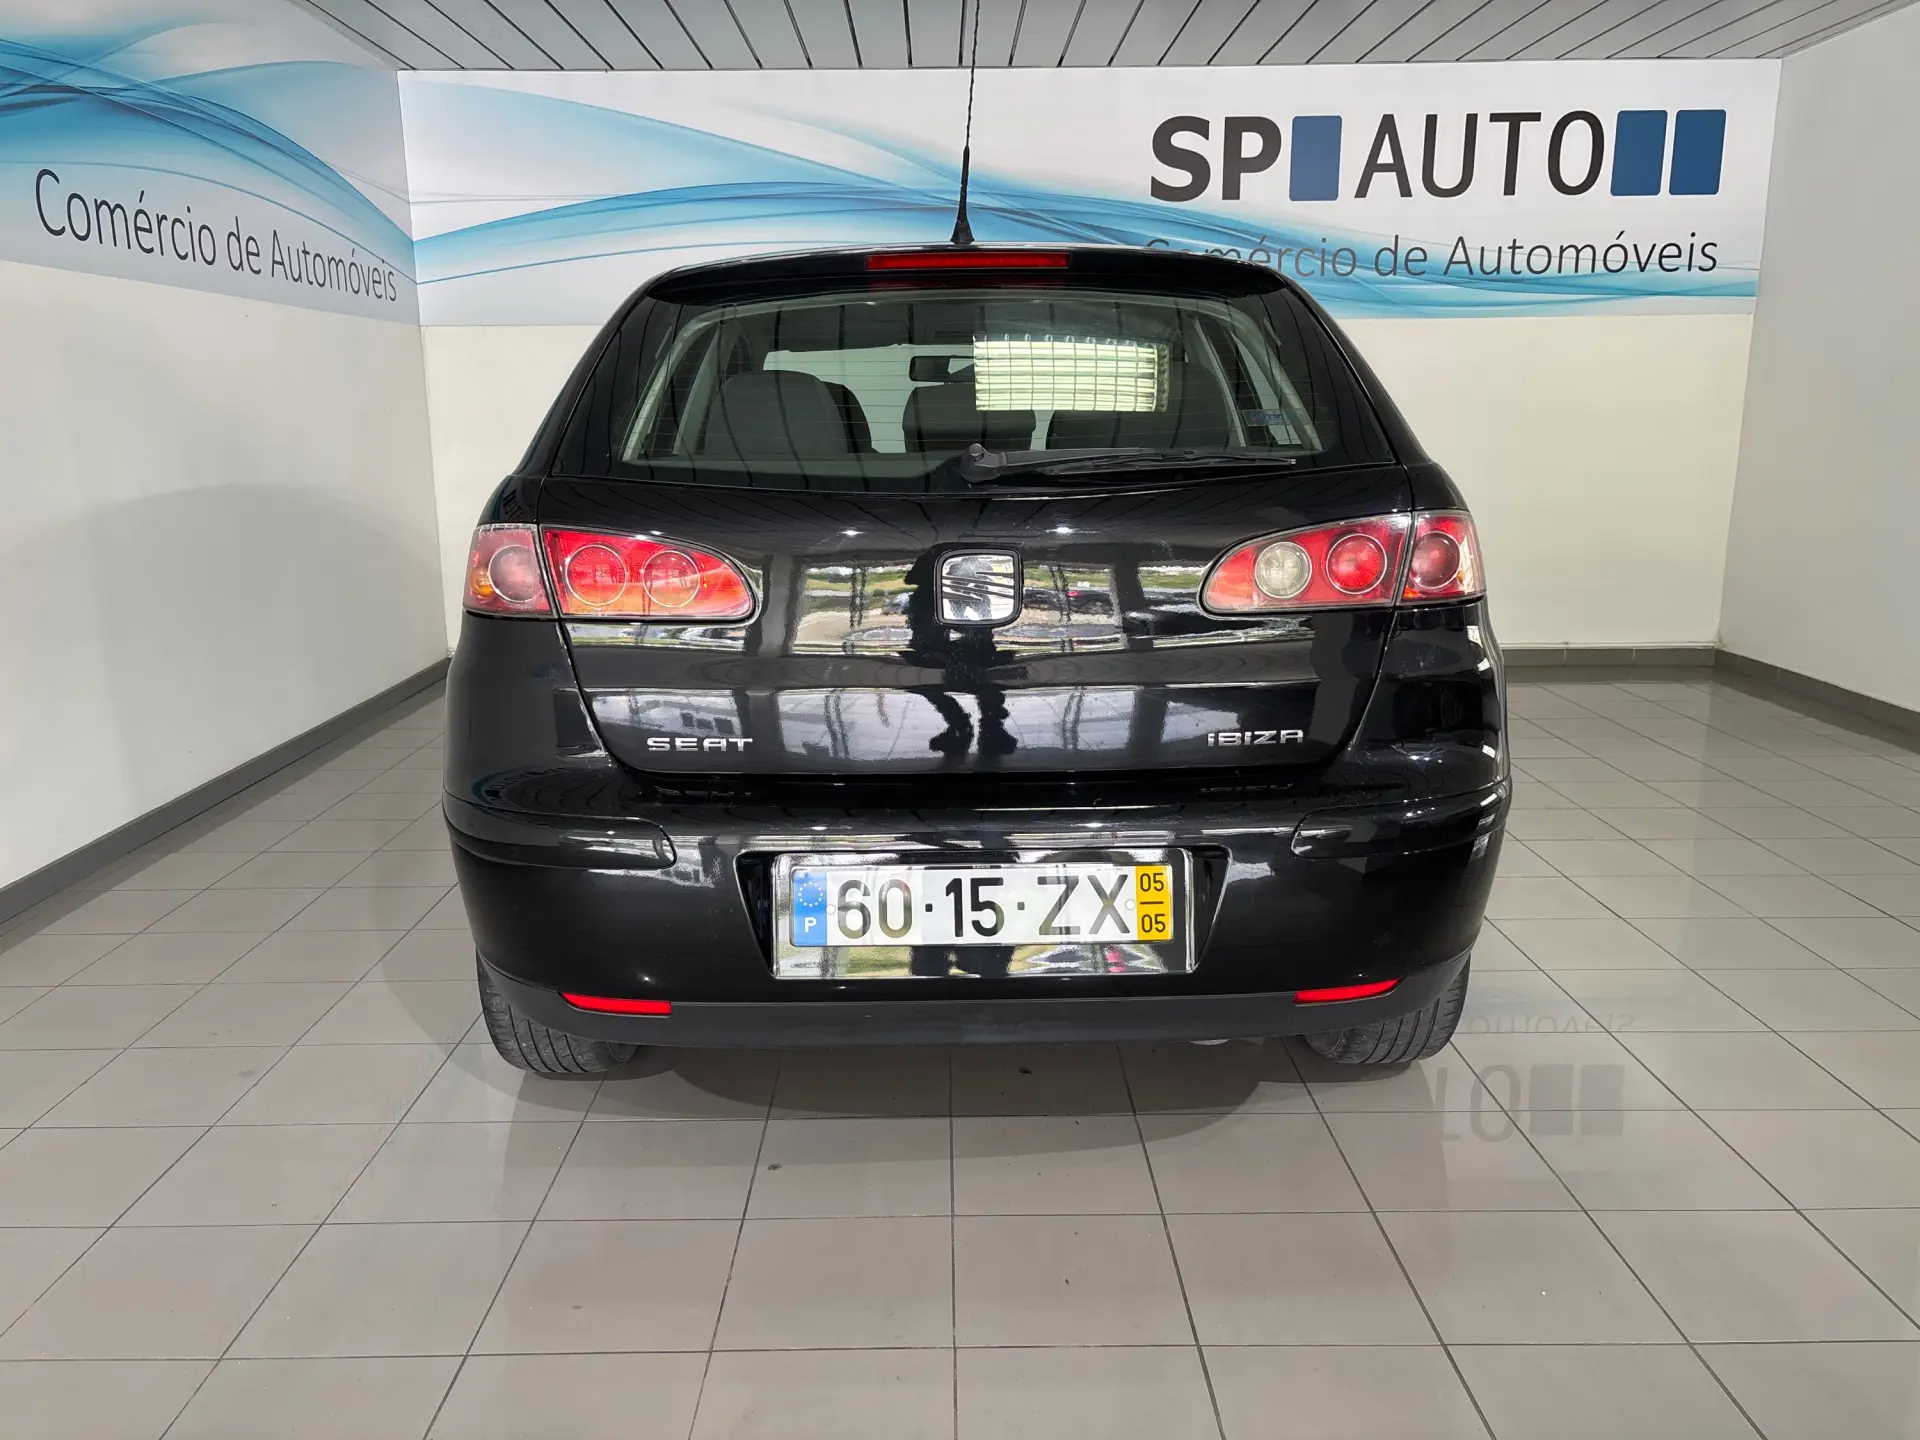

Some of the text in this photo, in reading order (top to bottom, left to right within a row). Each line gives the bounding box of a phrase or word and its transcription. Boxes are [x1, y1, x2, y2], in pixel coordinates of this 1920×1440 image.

[1150, 109, 1605, 202] SP AUTO
[35, 167, 398, 302] Comércio de Automóveis
[1146, 230, 1718, 277] ércio de Automóveis
[646, 737, 753, 752] SEAT
[1139, 872, 1165, 893] 05
[803, 917, 817, 933] P
[1141, 913, 1167, 934] 05
